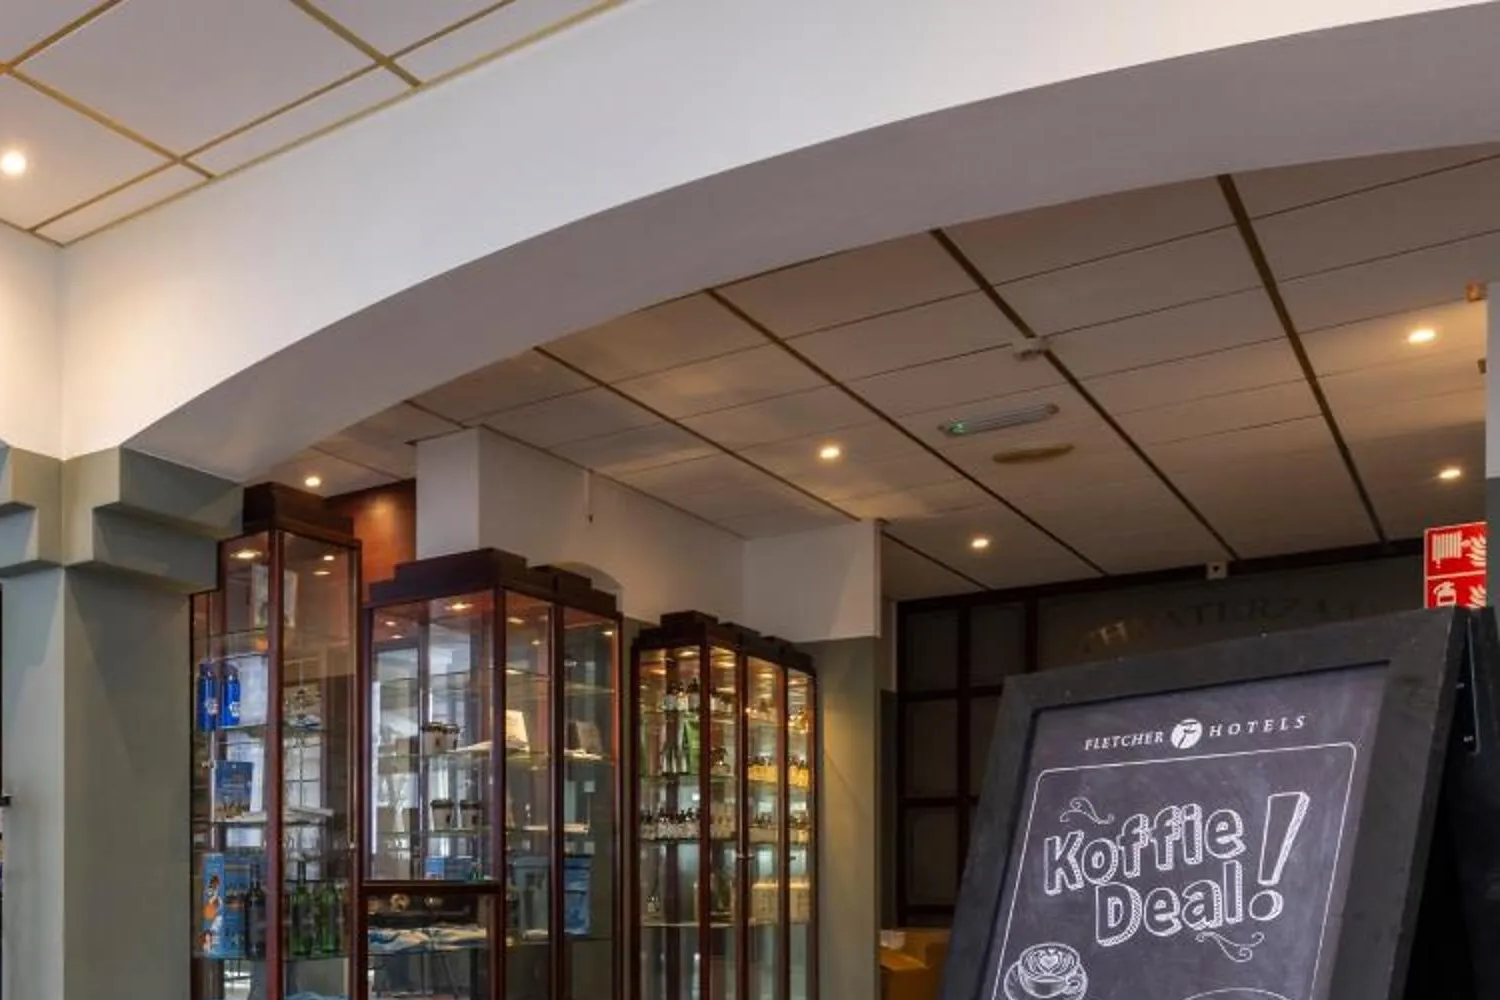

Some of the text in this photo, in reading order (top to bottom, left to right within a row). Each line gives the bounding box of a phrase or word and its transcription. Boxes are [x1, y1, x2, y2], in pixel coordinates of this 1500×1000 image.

[1084, 731, 1164, 750] FLETCHER
[1209, 715, 1307, 738] HOTELS
[1043, 803, 1247, 896] Koffie
